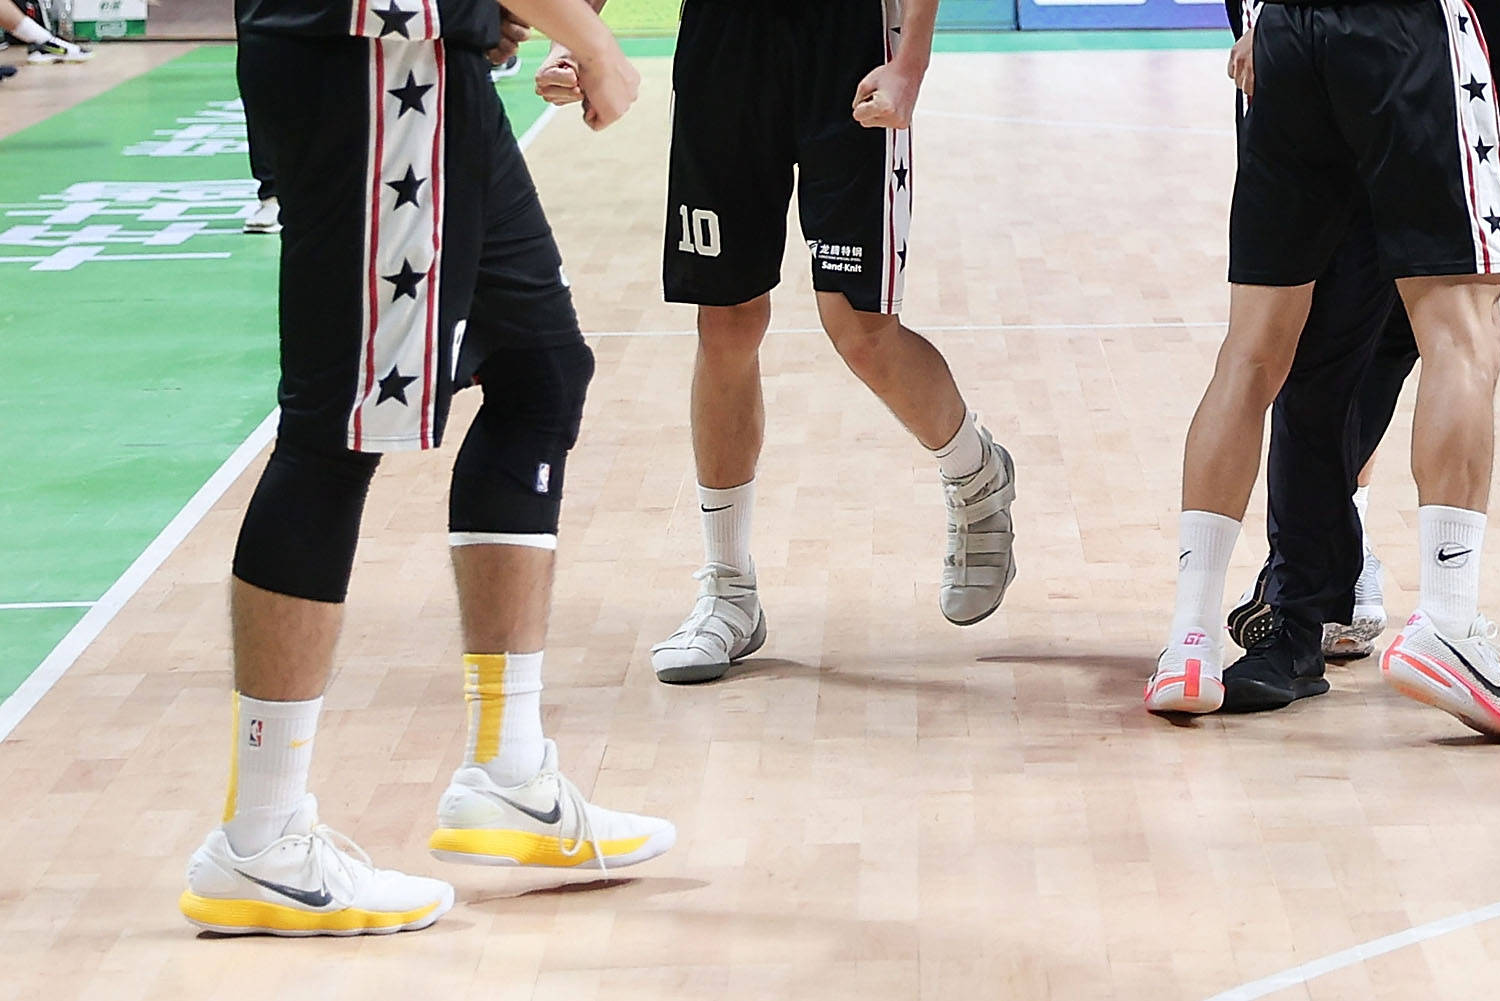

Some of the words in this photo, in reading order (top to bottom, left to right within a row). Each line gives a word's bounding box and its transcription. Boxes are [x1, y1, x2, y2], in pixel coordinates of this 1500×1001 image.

[679, 204, 721, 258] 10
[820, 244, 863, 257] 龙腾特钢
